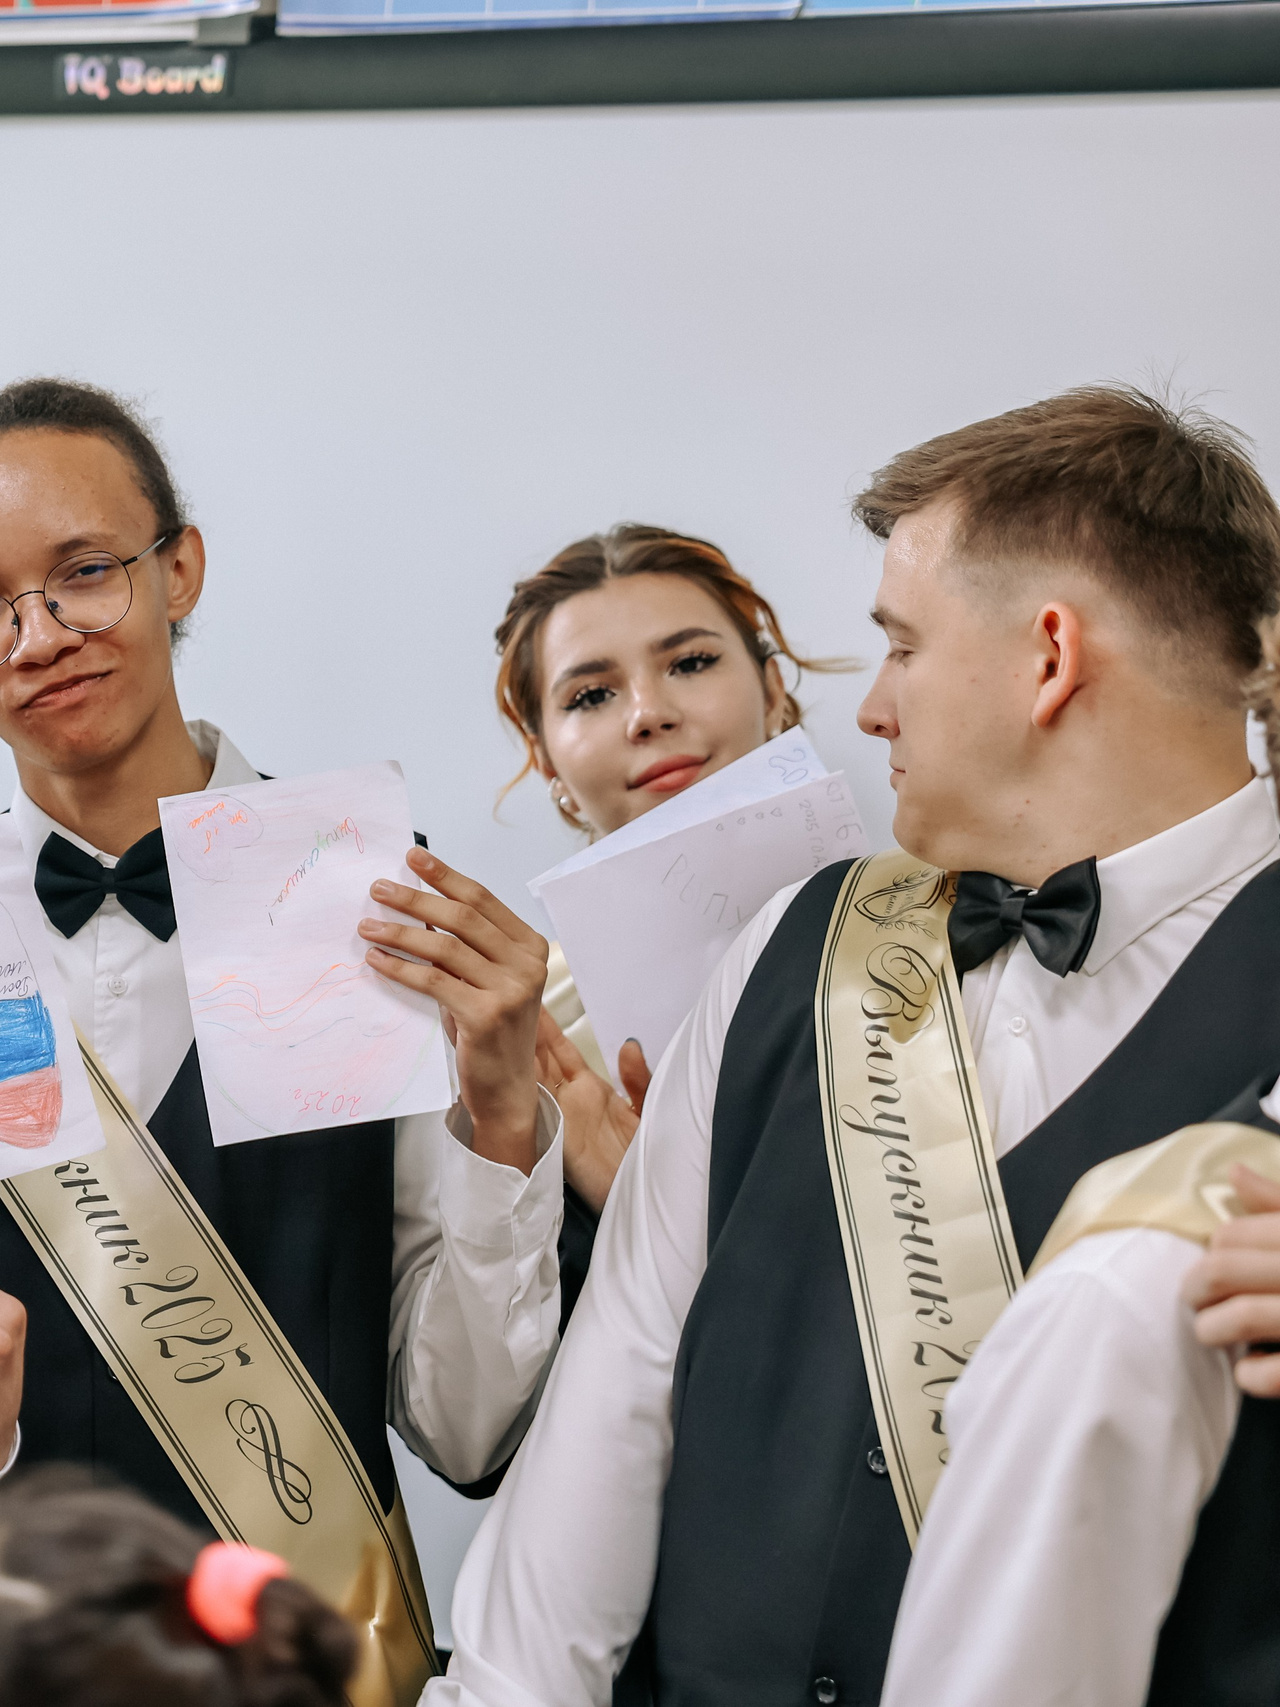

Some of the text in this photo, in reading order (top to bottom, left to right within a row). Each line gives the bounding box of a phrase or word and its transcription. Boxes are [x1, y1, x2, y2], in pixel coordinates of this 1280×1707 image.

[64, 54, 226, 100] IQ Board
[838, 941, 954, 1331] Выпускник
[118, 1264, 256, 1385] 2025
